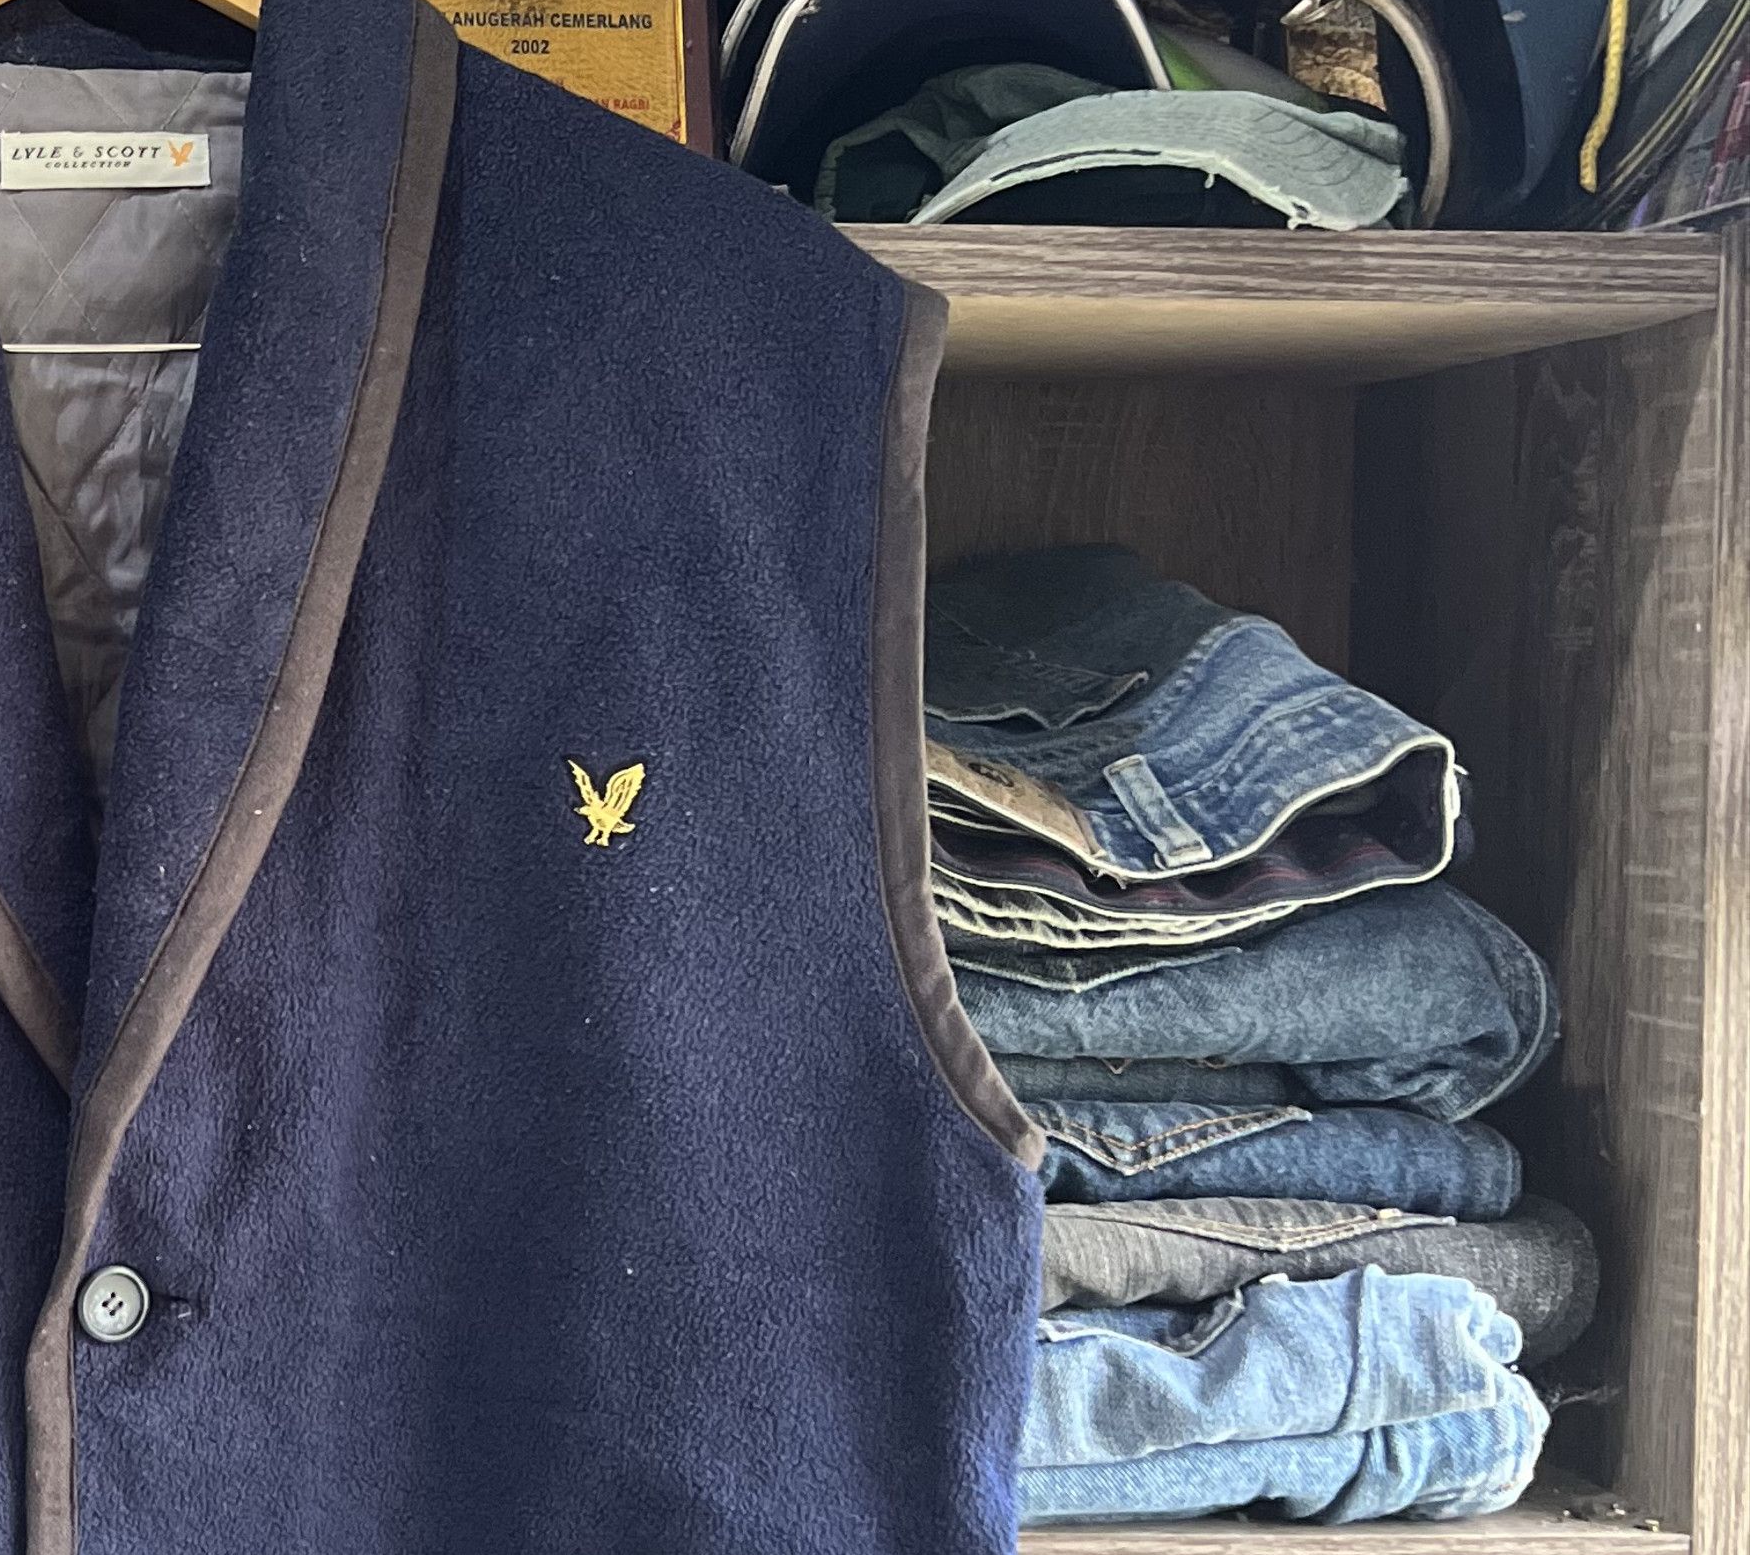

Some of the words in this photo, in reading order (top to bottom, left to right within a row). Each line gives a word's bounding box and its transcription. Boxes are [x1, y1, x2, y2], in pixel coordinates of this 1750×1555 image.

[452, 11, 545, 28] ANUGERAH
[550, 12, 653, 29] CEMERLANG
[511, 39, 550, 55] 2002
[11, 146, 62, 161] LYLE
[73, 145, 84, 159] &
[94, 146, 162, 160] SCOTT
[45, 160, 131, 170] COLLECTION
